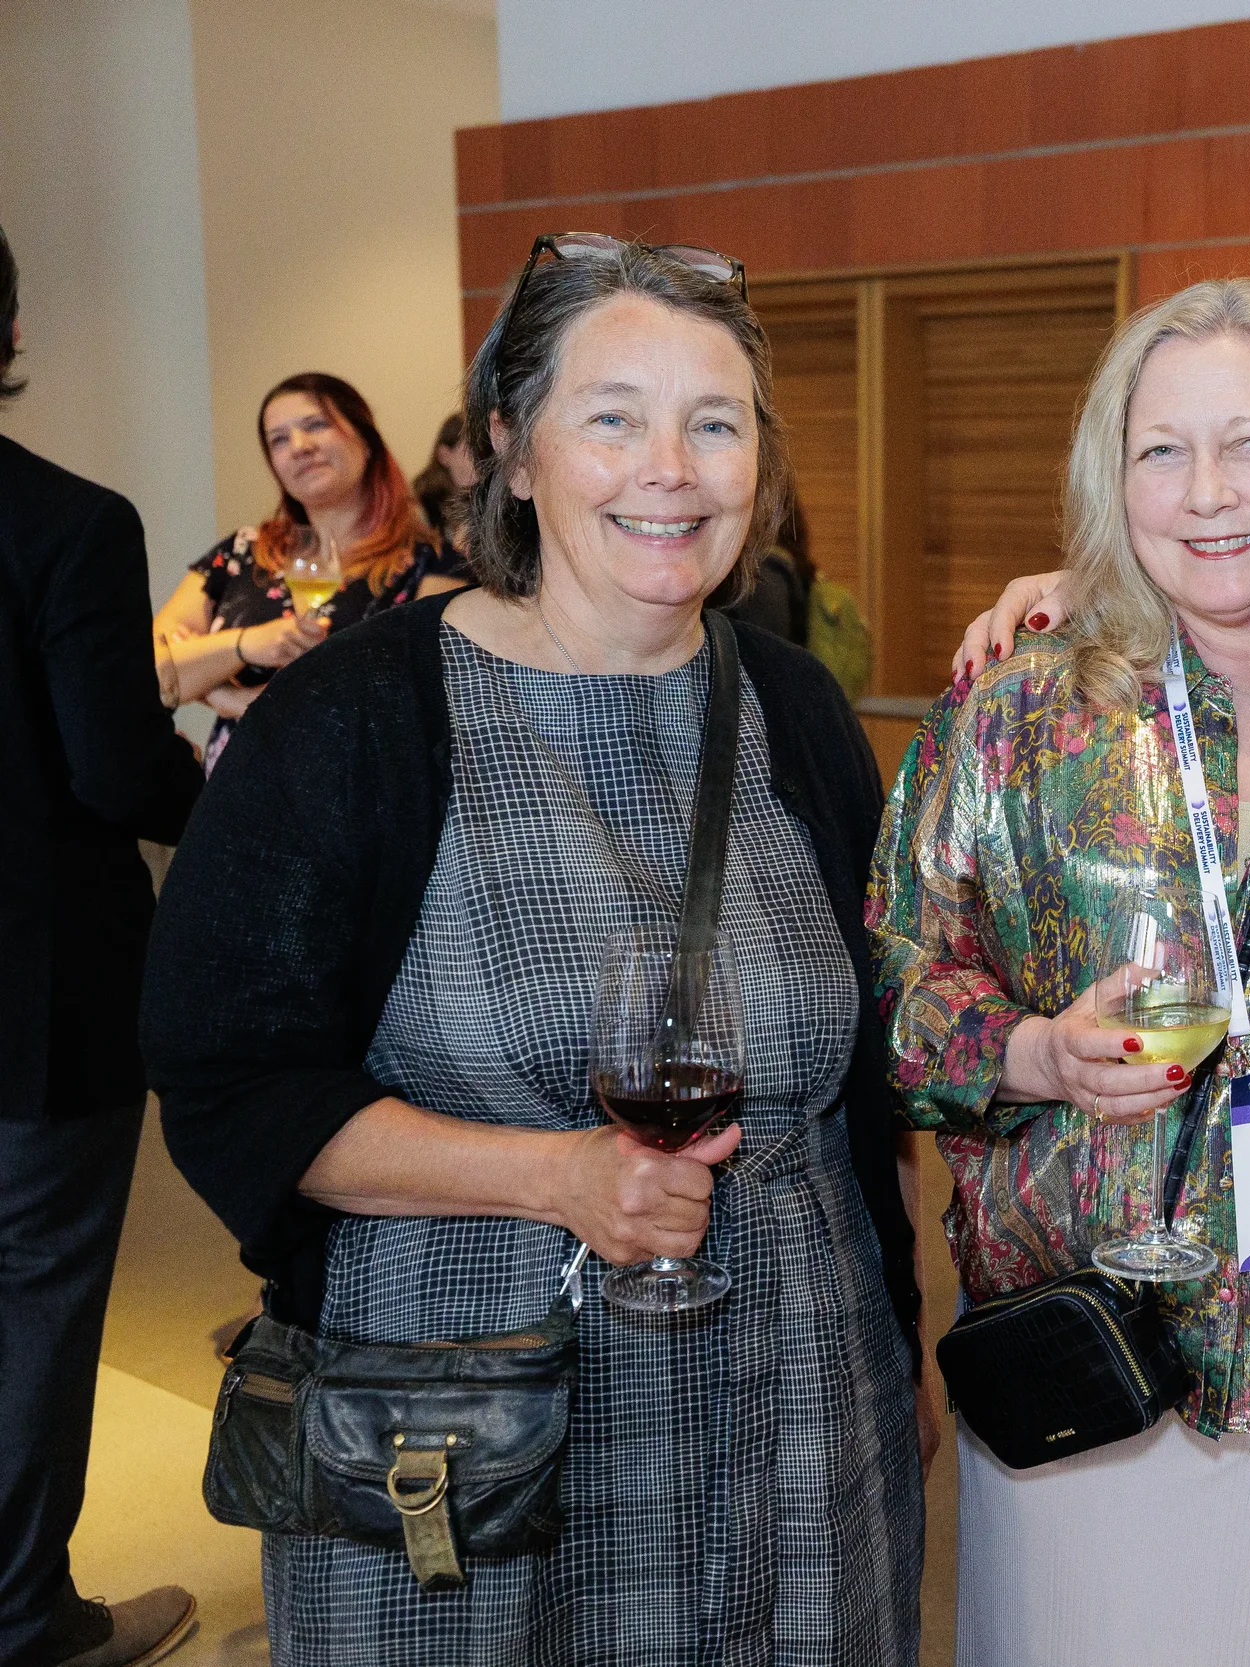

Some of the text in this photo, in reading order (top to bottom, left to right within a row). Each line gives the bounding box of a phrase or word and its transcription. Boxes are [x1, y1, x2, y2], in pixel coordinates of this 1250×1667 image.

[1174, 714, 1190, 770] DELIVERY SUMMIT
[1182, 712, 1196, 762] SUSTAINABILITY
[1193, 812, 1210, 874] DELIVERY SUMMIT
[1200, 811, 1216, 864] SUSTAINABILITY
[1217, 962, 1226, 991] SUMMIT
[1223, 922, 1238, 982] SUSTAINABILITY
